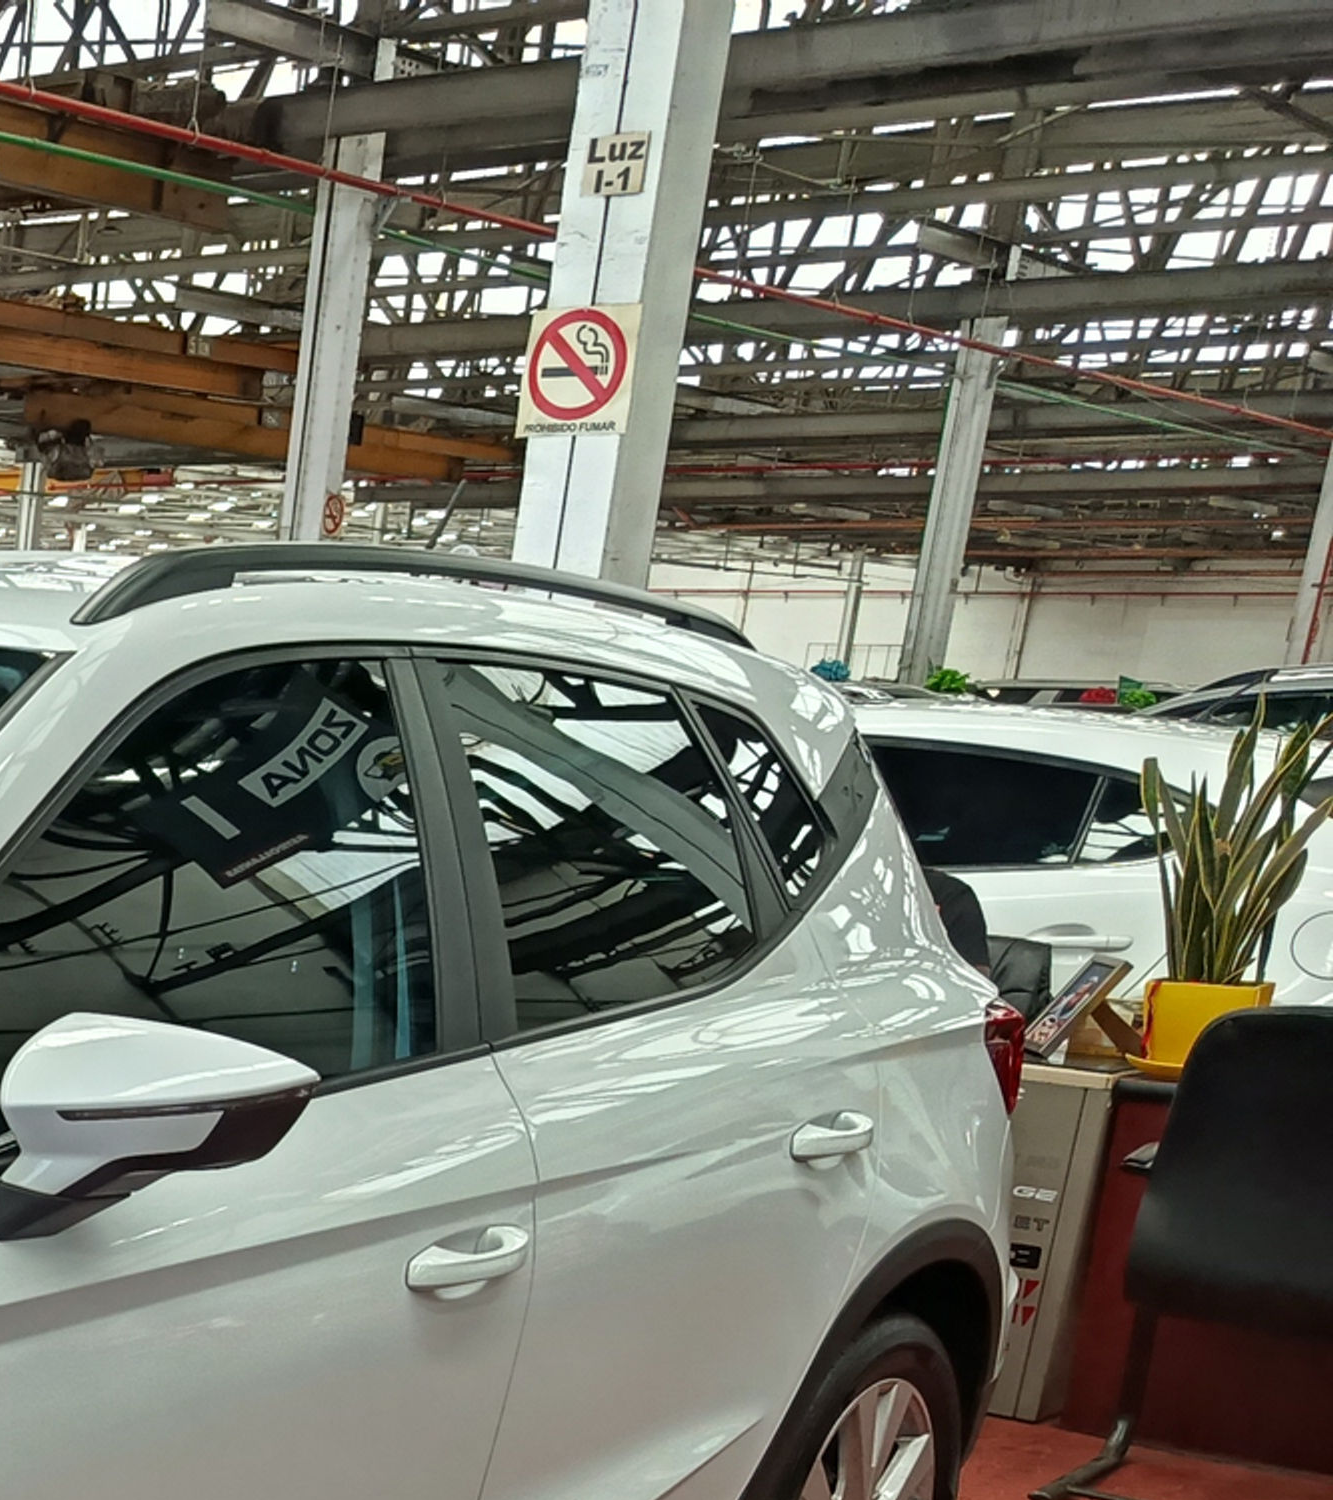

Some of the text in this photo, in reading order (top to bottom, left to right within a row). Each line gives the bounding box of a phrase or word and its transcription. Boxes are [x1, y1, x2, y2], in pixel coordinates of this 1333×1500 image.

[587, 138, 646, 164] Luz
[524, 421, 616, 433] PROHIBIDO FUMAR
